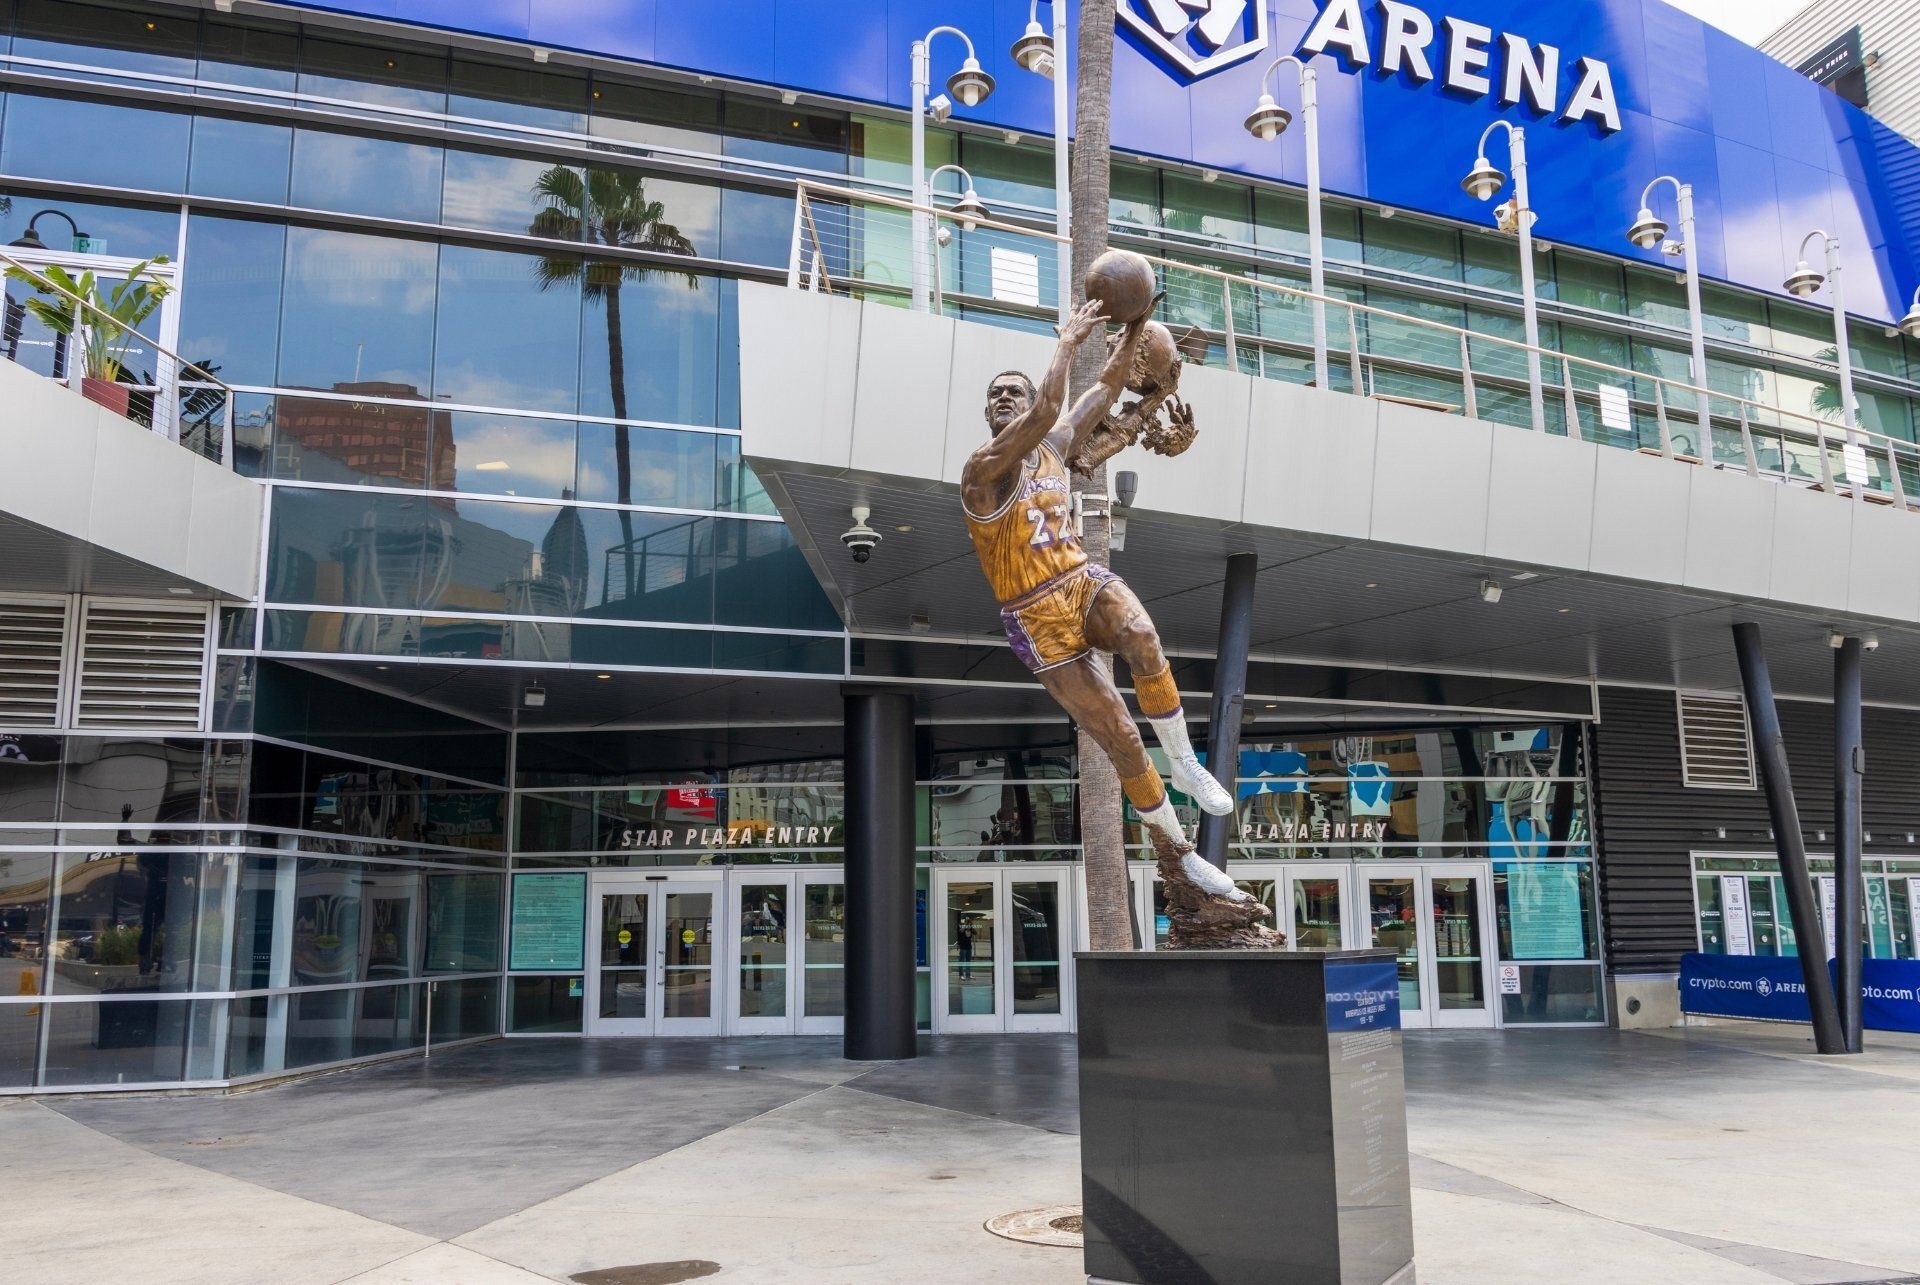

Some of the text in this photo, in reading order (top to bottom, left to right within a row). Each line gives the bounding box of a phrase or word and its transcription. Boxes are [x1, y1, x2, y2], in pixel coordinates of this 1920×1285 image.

[1300, 0, 1622, 132] ARENA
[1242, 822, 1388, 839] PLAZA ENTRY
[621, 826, 835, 847] STAR PLAZA ENTRY
[793, 853, 799, 863] 2
[1279, 848, 1285, 859] 5
[1417, 847, 1423, 858] 6
[1701, 859, 1706, 869] 1
[1752, 860, 1759, 870] 2
[1891, 862, 1897, 872] 5
[1690, 978, 1806, 993] crypto.com AREN
